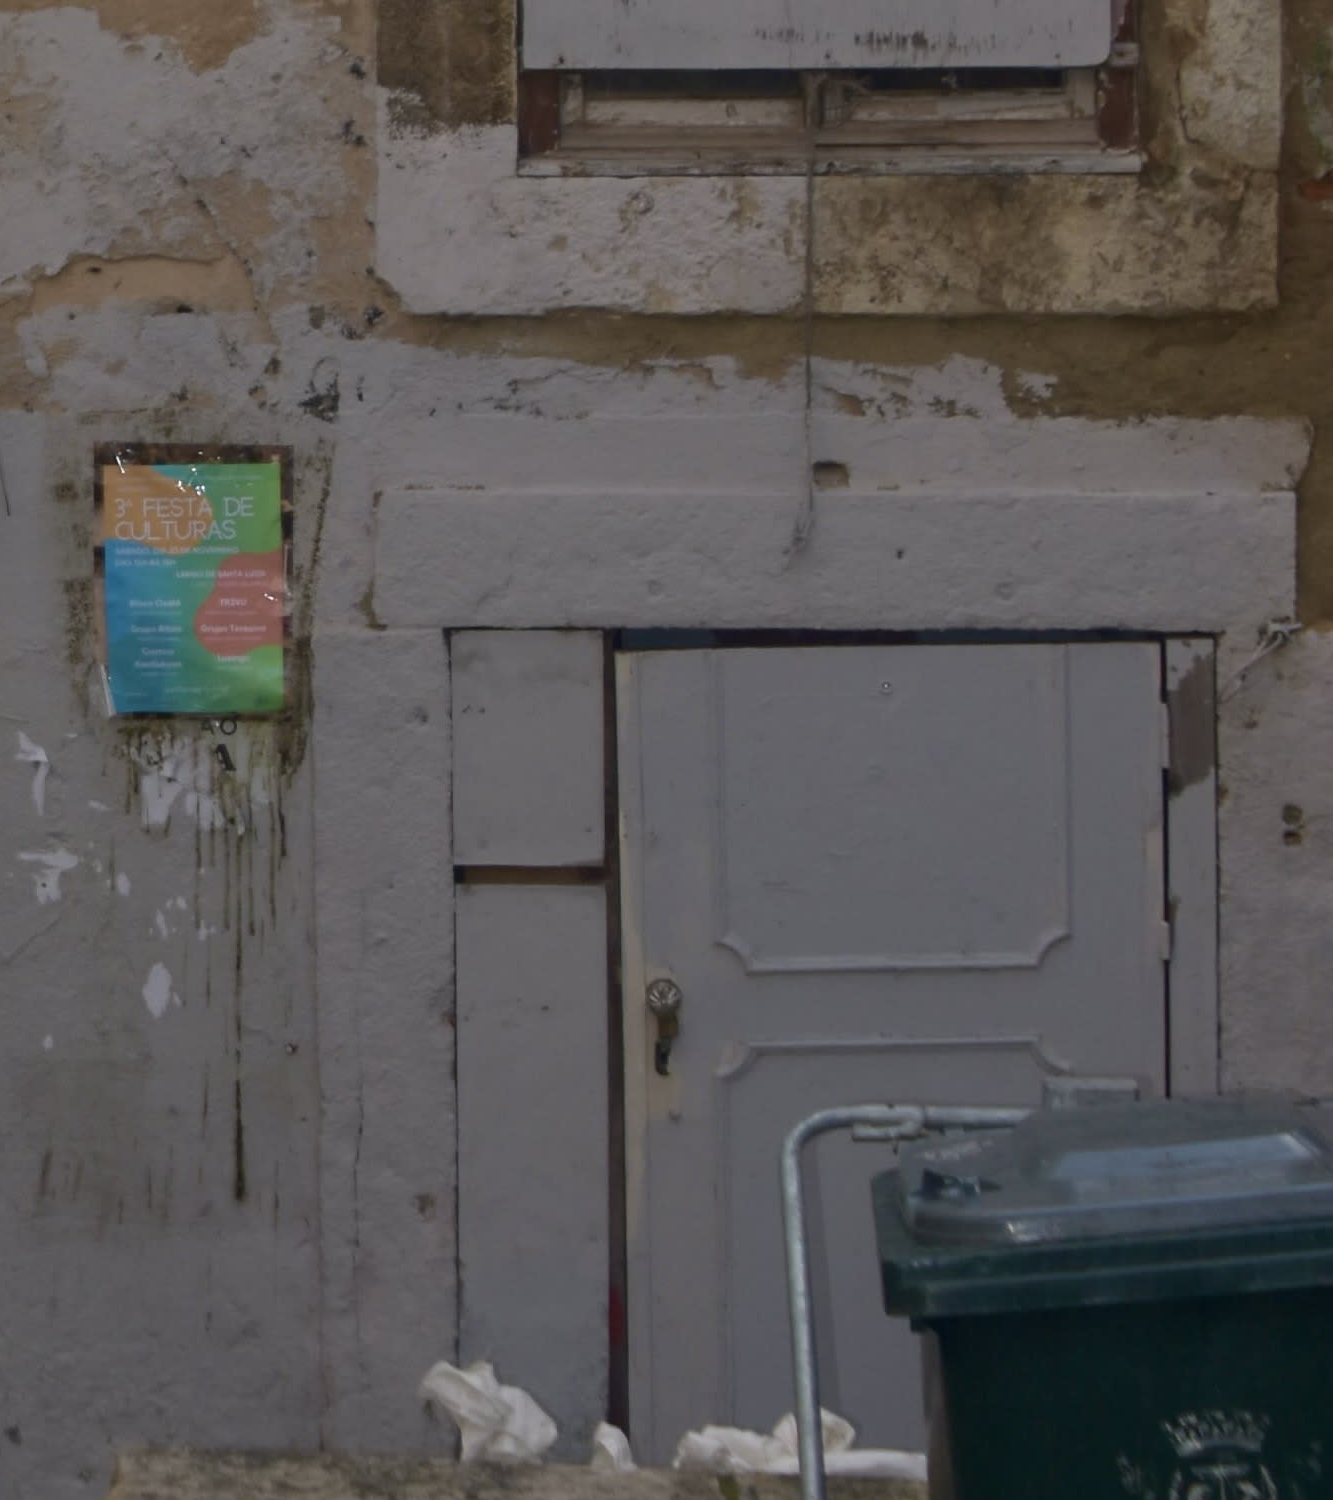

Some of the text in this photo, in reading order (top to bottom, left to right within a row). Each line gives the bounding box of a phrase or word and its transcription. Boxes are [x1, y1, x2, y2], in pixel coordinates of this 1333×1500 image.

[143, 497, 213, 518] FESTA
[224, 497, 255, 517] DE
[115, 519, 236, 540] CULTURAS
